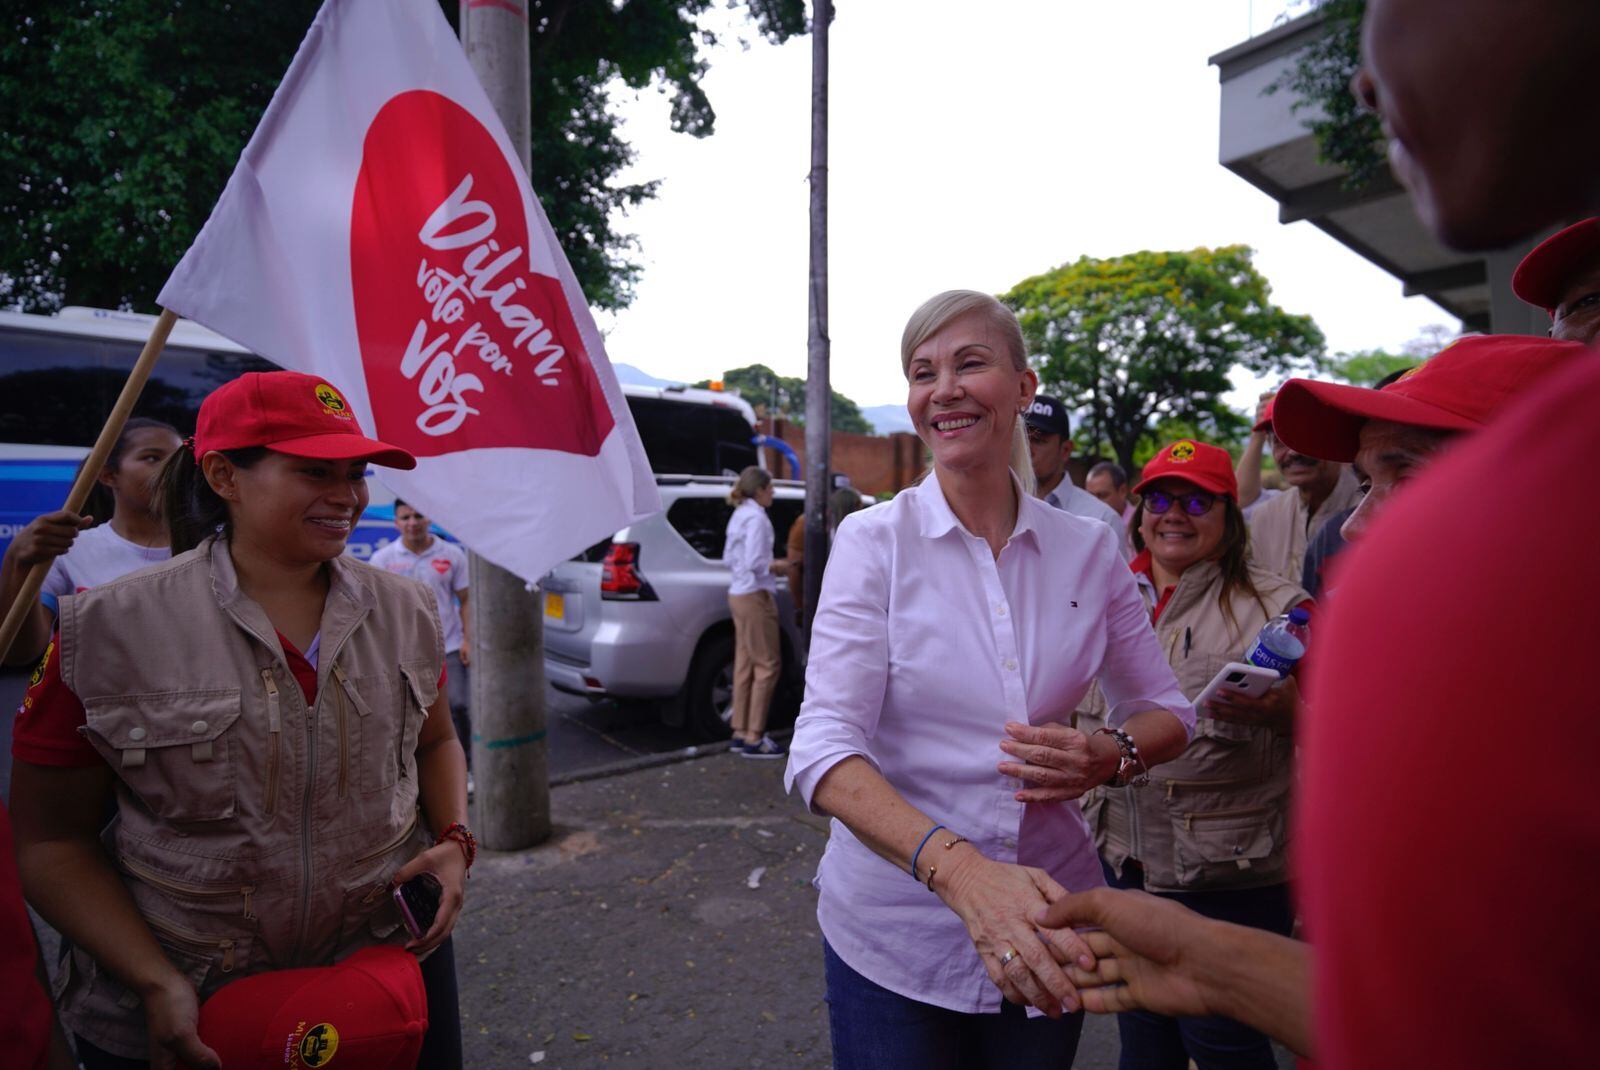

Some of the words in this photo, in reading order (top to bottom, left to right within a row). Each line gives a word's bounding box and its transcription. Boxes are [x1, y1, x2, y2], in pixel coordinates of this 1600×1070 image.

[416, 258, 476, 325] voto
[453, 321, 513, 378] por
[418, 172, 566, 387] Dilian,
